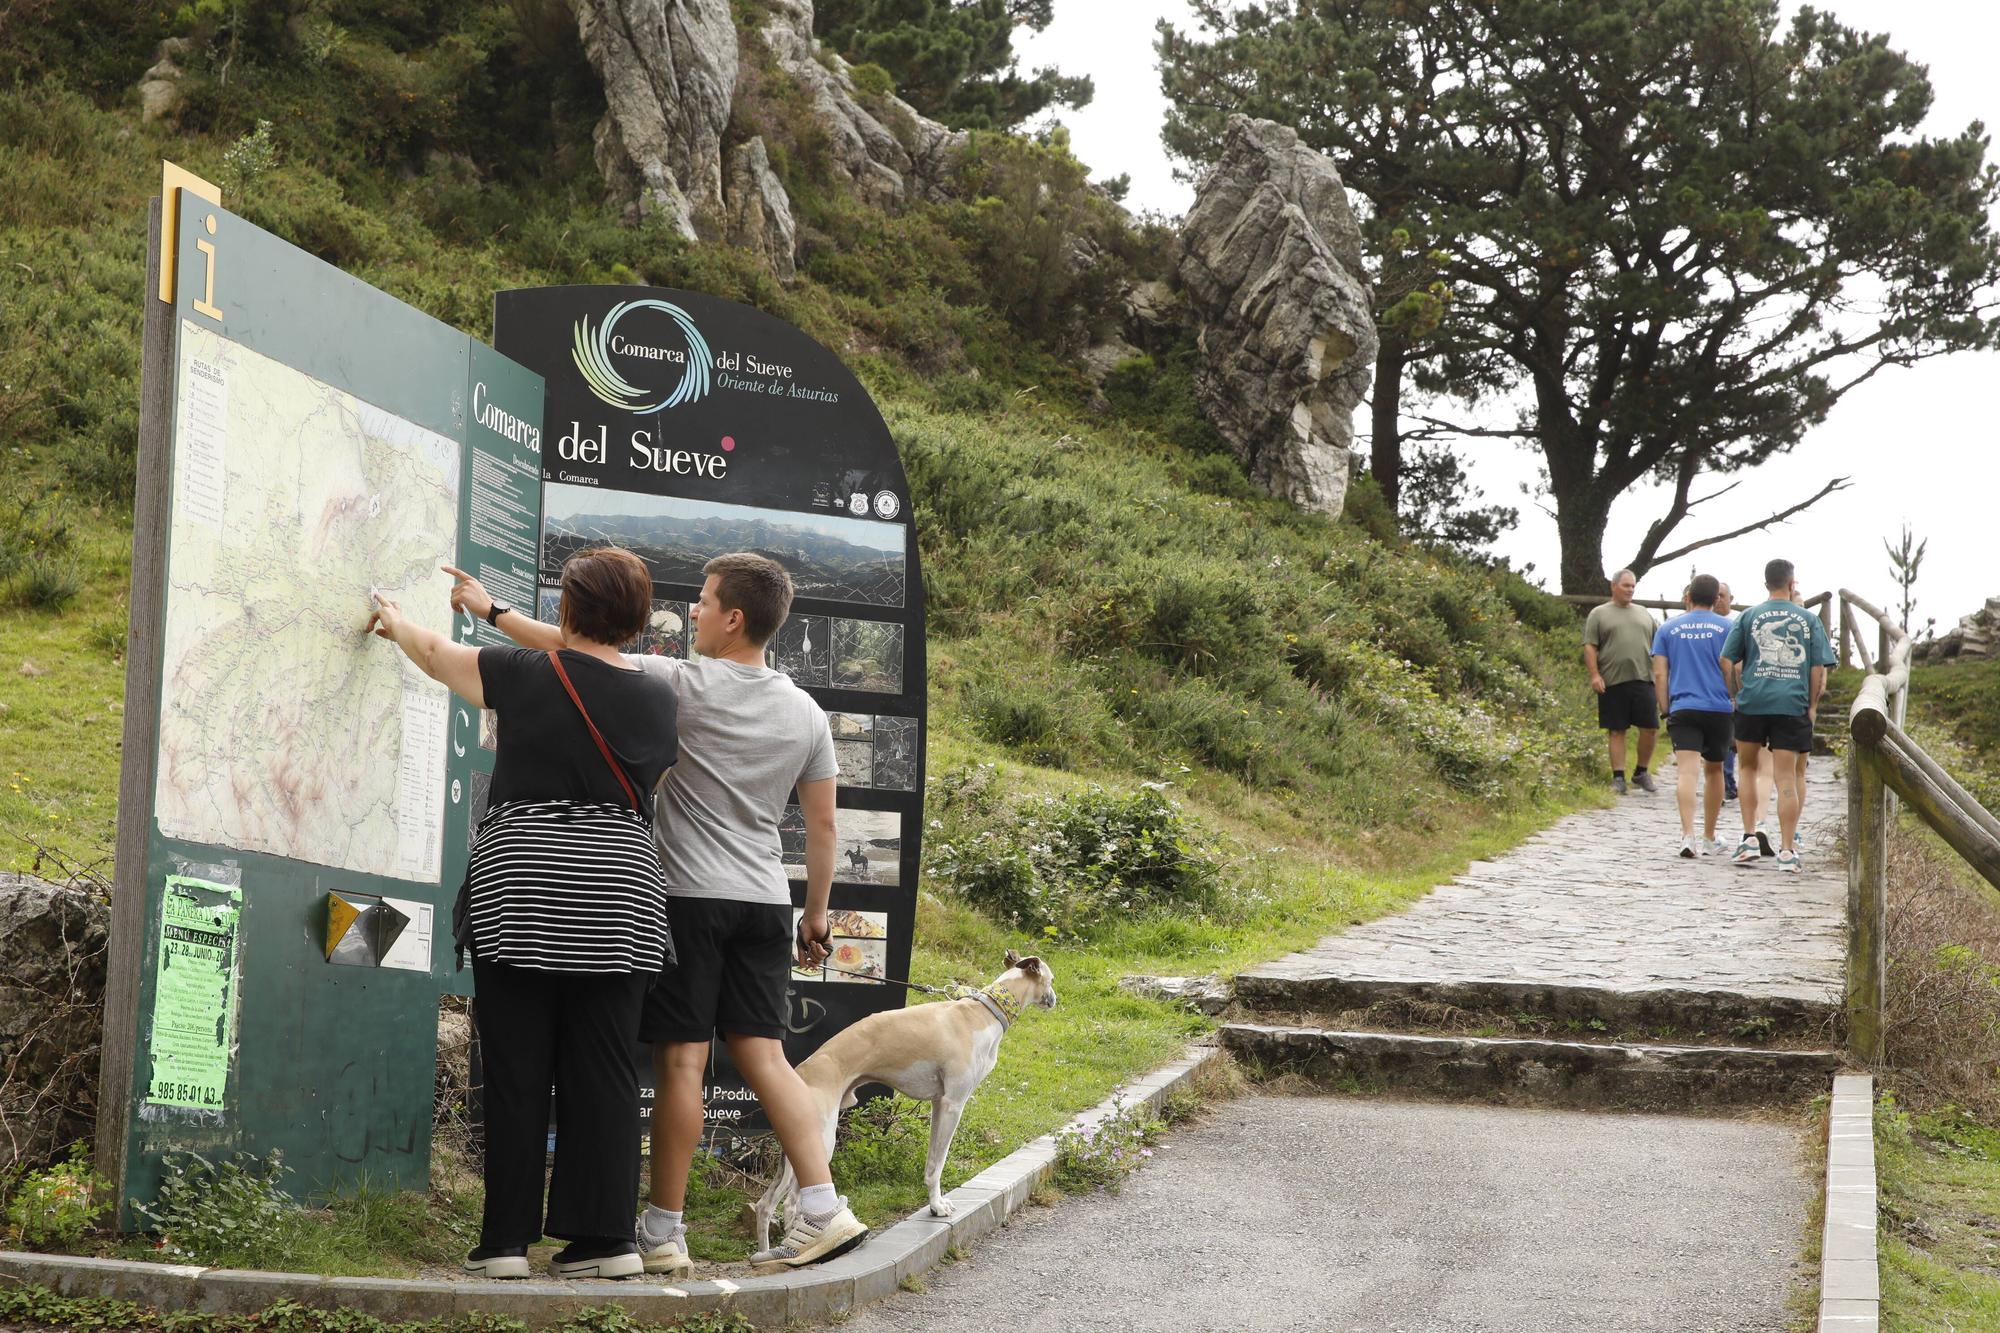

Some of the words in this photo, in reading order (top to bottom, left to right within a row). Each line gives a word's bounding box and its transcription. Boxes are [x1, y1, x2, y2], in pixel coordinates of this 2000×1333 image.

[611, 335, 685, 364] Comarca
[190, 366, 225, 386] SENDERISMO
[193, 359, 211, 373] RUTAS
[213, 368, 221, 376] DE
[716, 351, 740, 371] del
[746, 354, 793, 378] Sueve
[717, 372, 764, 393] Oriente
[768, 379, 783, 395] de
[786, 382, 839, 403] Asturias
[473, 382, 541, 454] Comarca
[558, 421, 607, 465] del
[629, 430, 727, 479] Sueve
[542, 468, 551, 480] la
[559, 470, 599, 485] Comarca
[1680, 632, 1713, 640] BOXEO
[1758, 610, 1789, 620] THEM
[1790, 612, 1811, 640] JUDGE
[165, 926, 190, 940] MENÚ
[170, 942, 178, 954] 23
[181, 944, 190, 957] 28
[193, 946, 212, 961] JUNIO
[158, 1081, 175, 1100] 985
[176, 1083, 188, 1101] 85
[189, 1085, 202, 1104] 01
